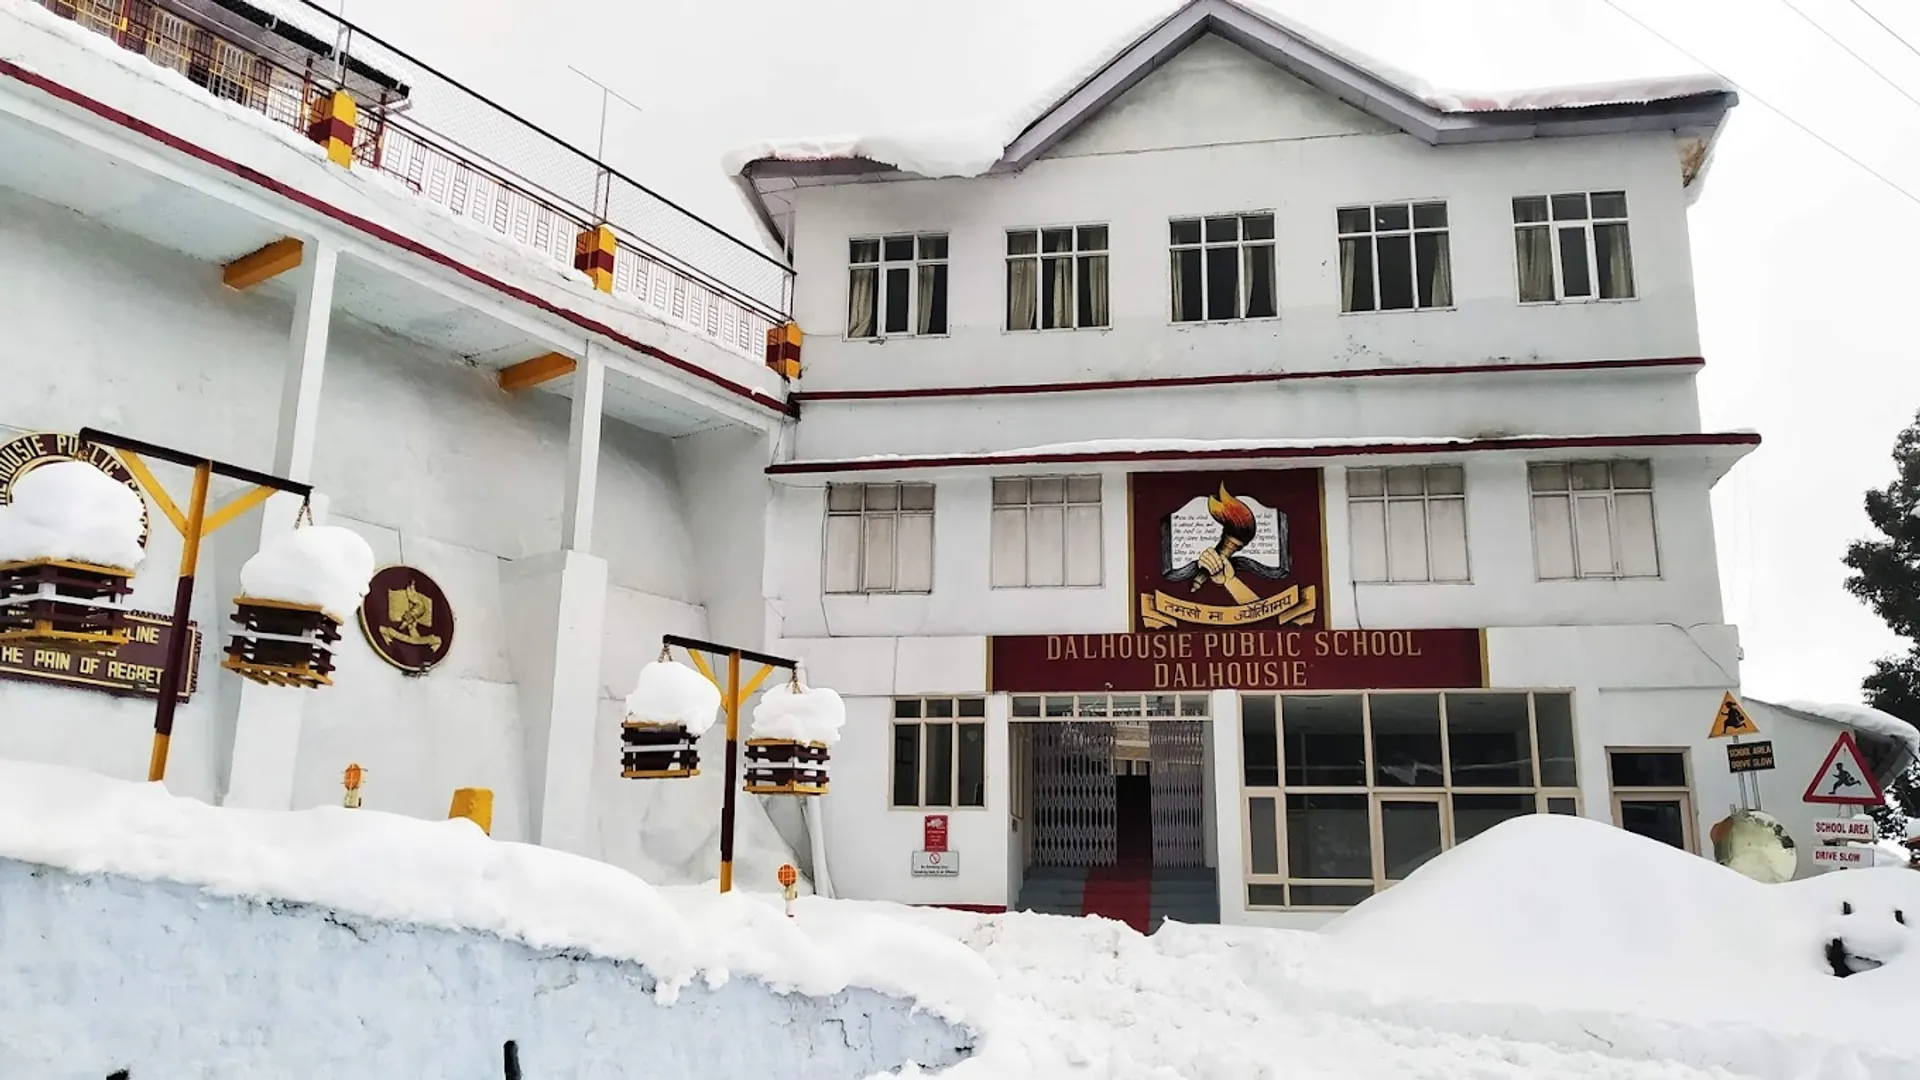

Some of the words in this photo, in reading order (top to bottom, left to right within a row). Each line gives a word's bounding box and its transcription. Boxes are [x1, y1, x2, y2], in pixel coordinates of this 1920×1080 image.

[56, 434, 121, 477] PULIC
[1208, 610, 1224, 621] मा
[1046, 633, 1192, 660] DALHOUSIE
[1205, 631, 1301, 658] PUBLIC
[1315, 630, 1422, 657] SCHOOL
[0, 646, 24, 664] HE
[34, 649, 71, 671] PAIN
[80, 656, 100, 675] OF
[107, 660, 165, 685] REGRET
[1154, 660, 1307, 688] DALHOUSIE
[1752, 757, 1773, 767] SLOW
[1815, 821, 1847, 834] SCHOOL
[1848, 823, 1869, 835] AREA
[1815, 850, 1837, 861] DRIVE
[1839, 852, 1861, 862] SLOW
